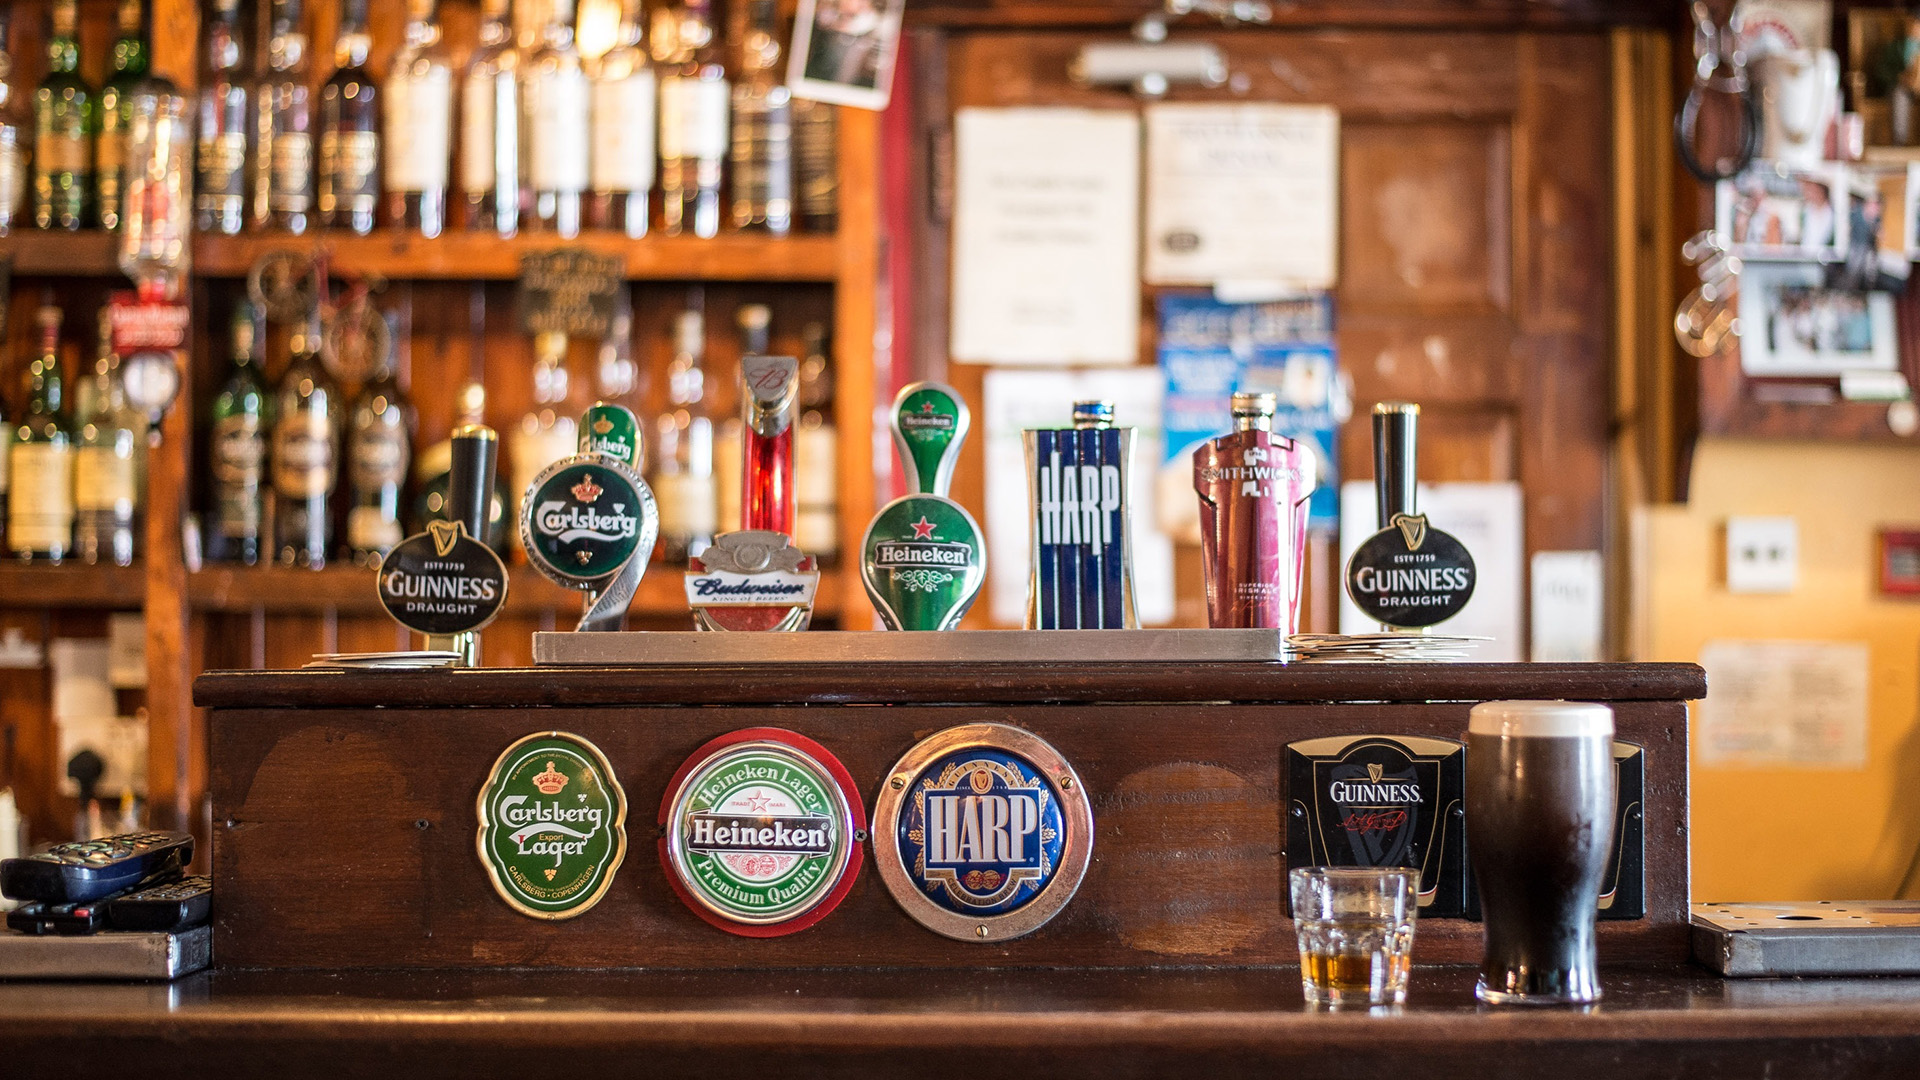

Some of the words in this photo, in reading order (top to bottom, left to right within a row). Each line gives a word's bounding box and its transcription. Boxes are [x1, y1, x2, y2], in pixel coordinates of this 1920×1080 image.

[1041, 451, 1120, 556] HARP
[536, 501, 638, 539] Carlsberg
[882, 546, 965, 564] Heineken
[1416, 554, 1436, 562] 1759
[386, 571, 495, 601] GUINNESS
[693, 578, 804, 596] Budweiser
[1356, 566, 1468, 592] GUINNESS
[406, 602, 478, 615] DRAUGHT
[1379, 595, 1452, 607] DRAUGHT
[698, 764, 778, 806] Heineken
[779, 768, 823, 810] Lager
[948, 761, 1014, 786] GUINNESS
[1330, 781, 1420, 803] GUINNESS
[500, 795, 603, 830] Carlsberg
[539, 833, 564, 842] Export
[693, 819, 827, 848] Heineken
[929, 795, 1038, 863] HARP
[517, 835, 588, 867] Lager
[509, 865, 546, 898] CARLSBERG
[551, 864, 595, 898] COPENHAGEN
[697, 858, 765, 904] Premium
[767, 861, 822, 905] Quality
[948, 878, 996, 905] CELEBRATION
